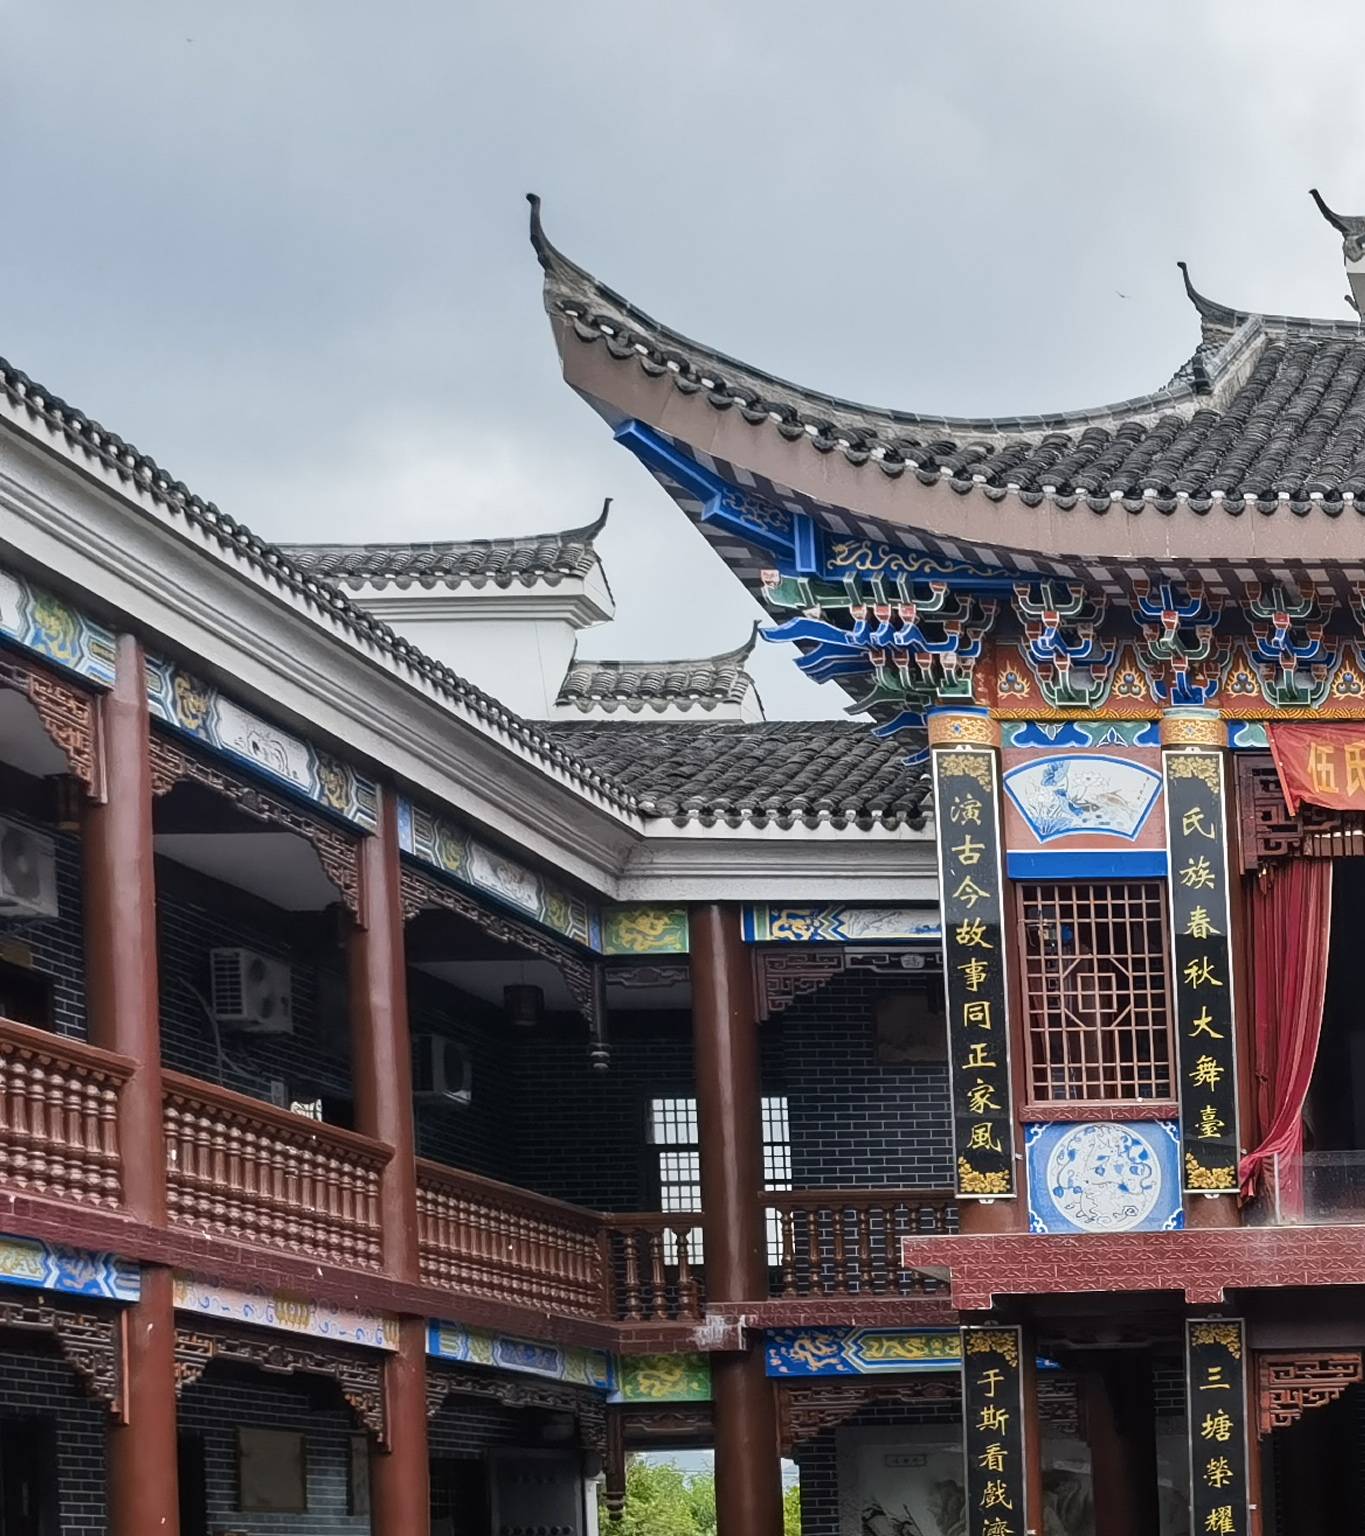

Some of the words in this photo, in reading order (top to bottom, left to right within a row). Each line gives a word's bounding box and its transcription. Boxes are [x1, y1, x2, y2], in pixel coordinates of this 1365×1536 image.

[950, 794, 1002, 1154] 演古今故事同正家風
[1178, 806, 1226, 1140] 氏族春秋大舞臺
